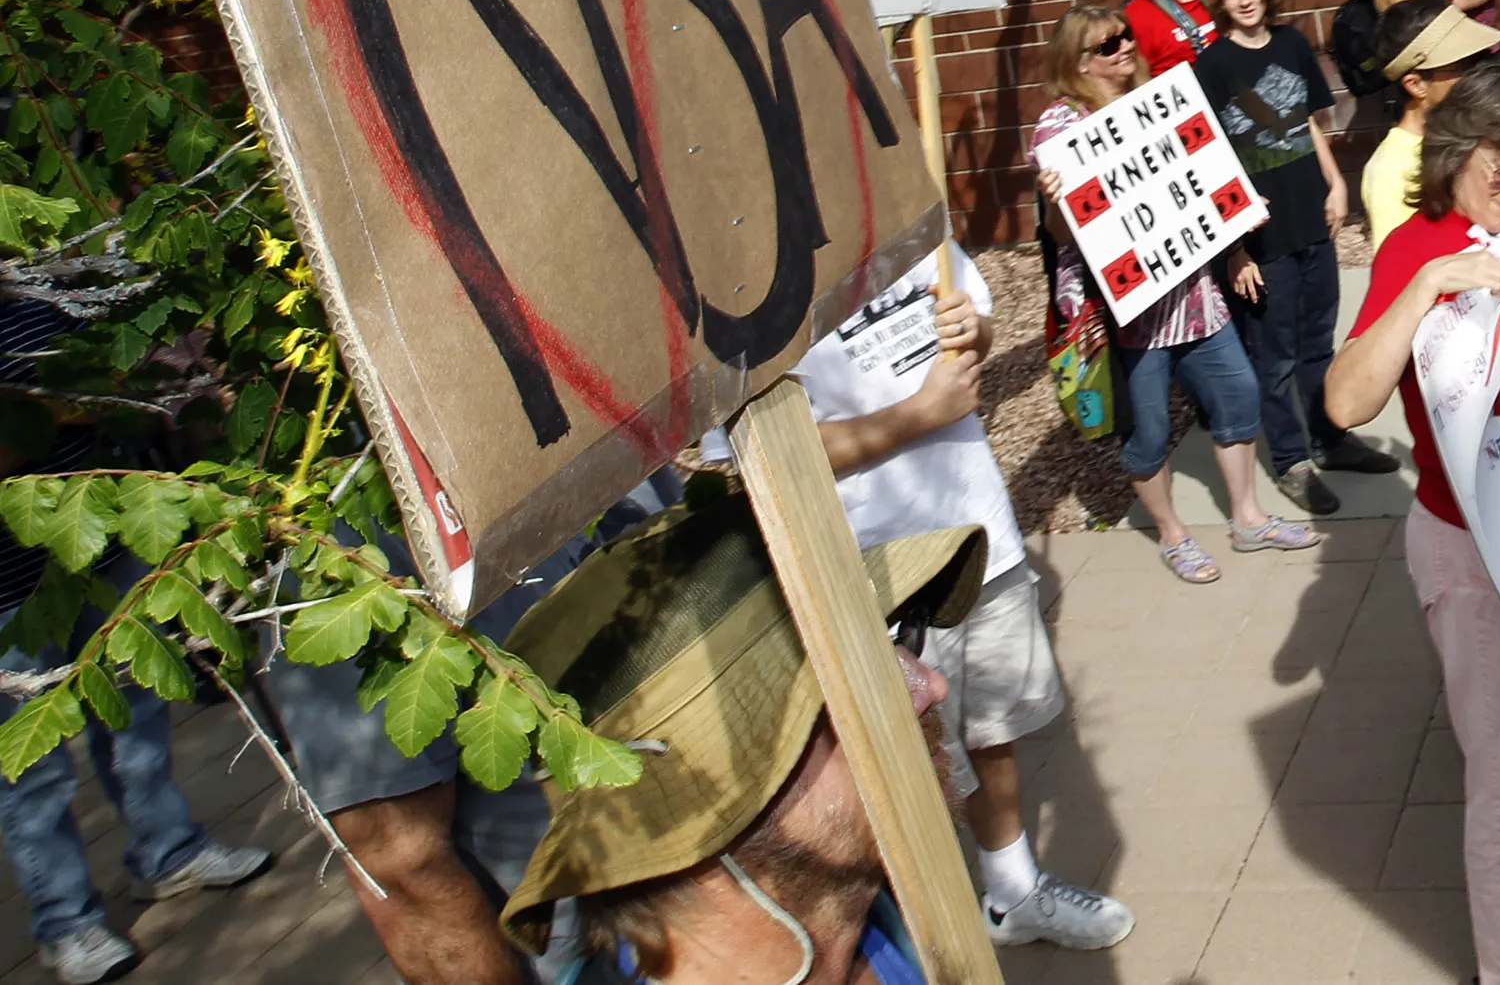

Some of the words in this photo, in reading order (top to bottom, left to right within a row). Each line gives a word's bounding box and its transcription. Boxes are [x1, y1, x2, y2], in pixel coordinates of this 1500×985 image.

[1067, 116, 1124, 166] THE
[1132, 84, 1190, 130] NSA
[1103, 133, 1178, 200] KNEW
[1120, 202, 1155, 243] I'D
[1168, 169, 1205, 211] BE
[1144, 213, 1217, 283] HERE
